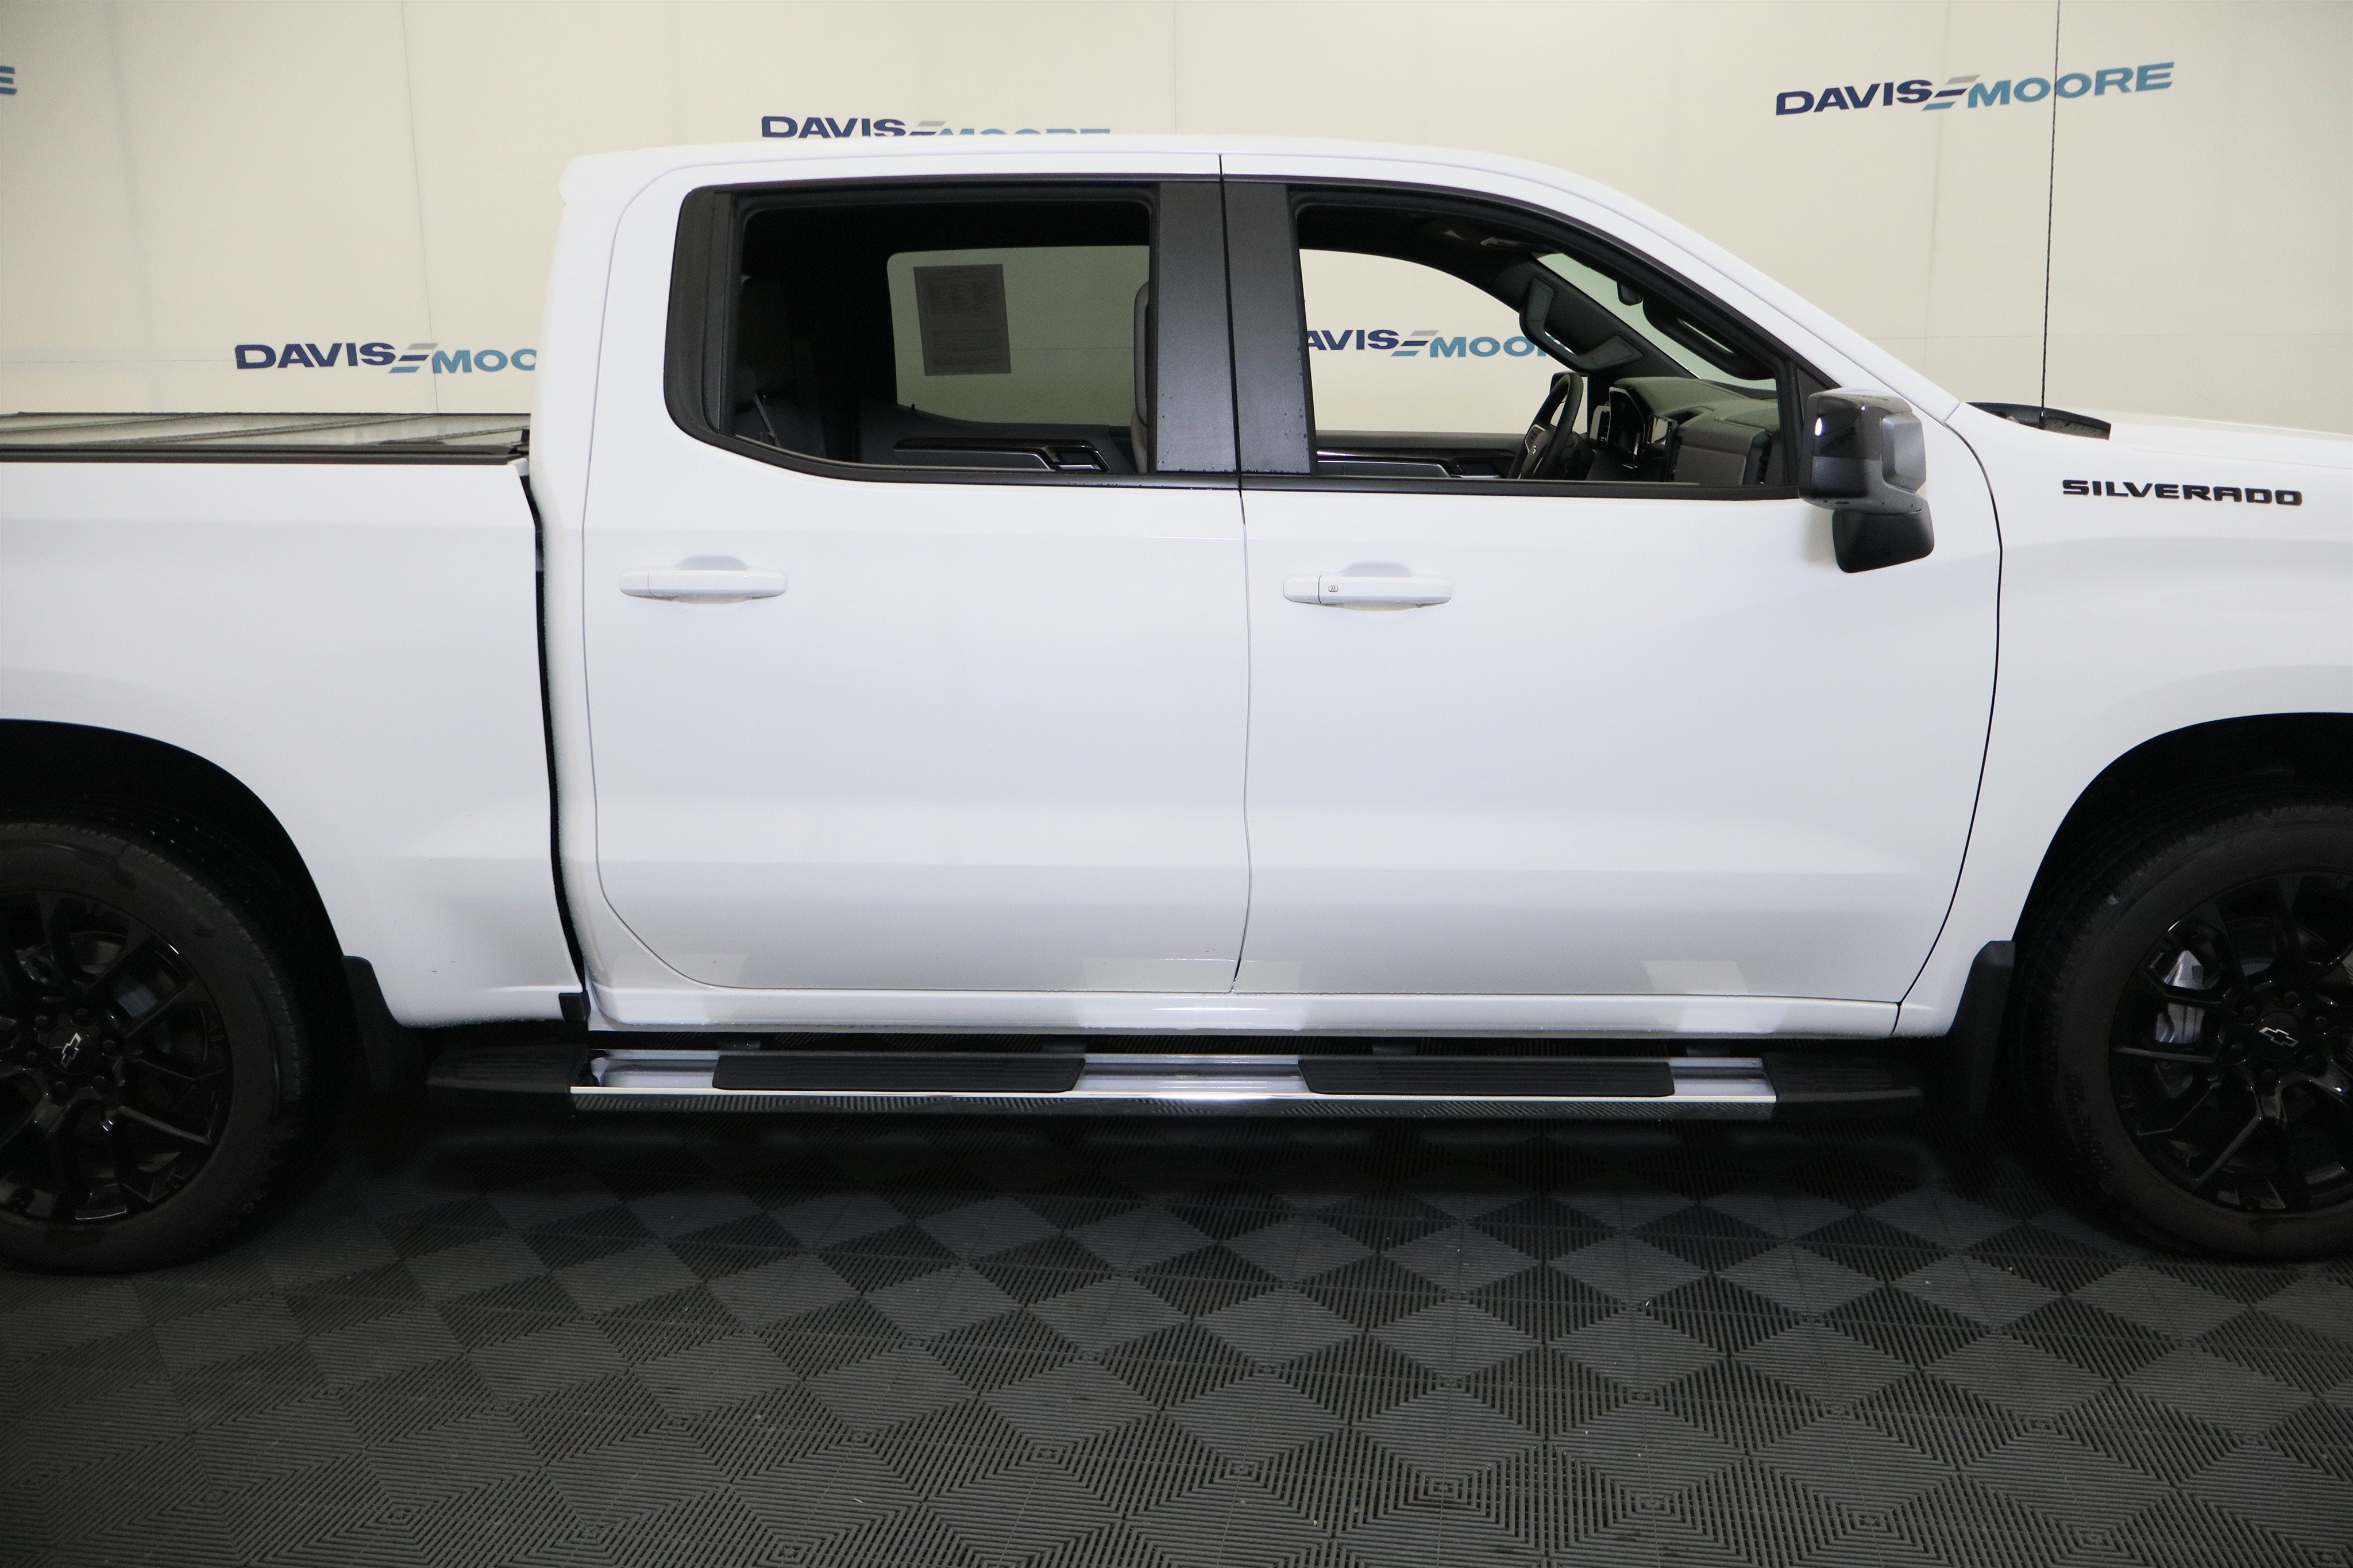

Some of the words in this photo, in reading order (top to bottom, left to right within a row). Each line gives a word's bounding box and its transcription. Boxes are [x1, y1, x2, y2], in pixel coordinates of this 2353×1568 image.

[1776, 79, 1933, 116] DAVIS
[1967, 61, 2175, 109] MOORE
[761, 116, 907, 138] DAVIS
[1307, 330, 1399, 350] AVIS
[1430, 336, 1546, 357] MOO
[234, 342, 396, 369] DAVIS
[431, 349, 537, 373] MOO
[2062, 479, 2302, 506] SILVERADO
